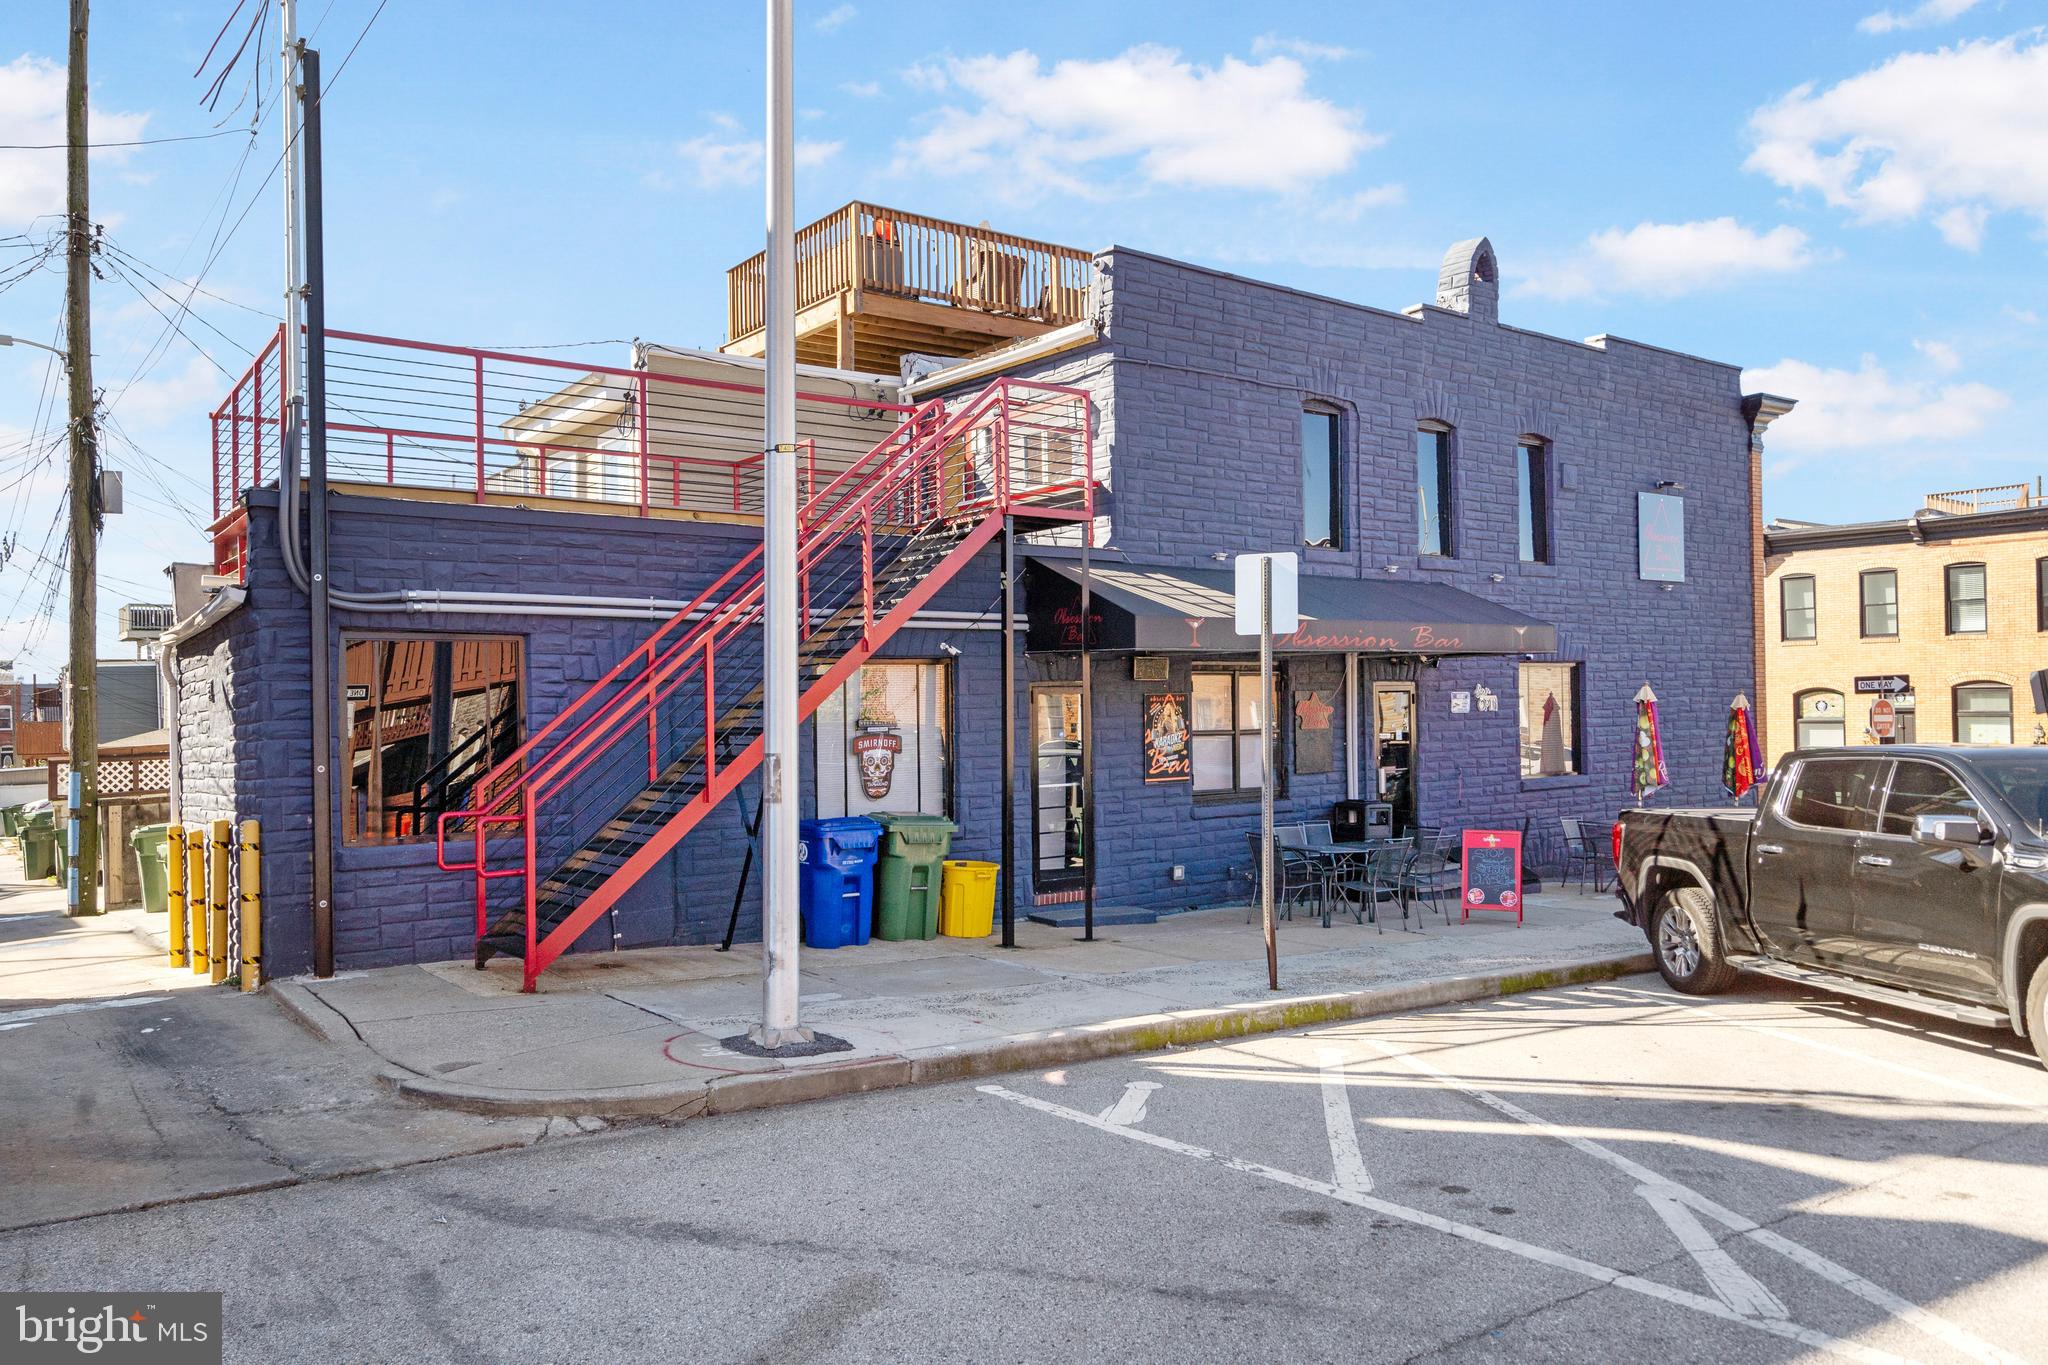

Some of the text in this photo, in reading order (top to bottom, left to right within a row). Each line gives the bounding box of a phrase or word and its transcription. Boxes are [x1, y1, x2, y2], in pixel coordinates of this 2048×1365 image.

[1410, 625, 1464, 648] Bar
[1860, 681, 1876, 689] ONE
[858, 738, 897, 750] SMIRNOFF
